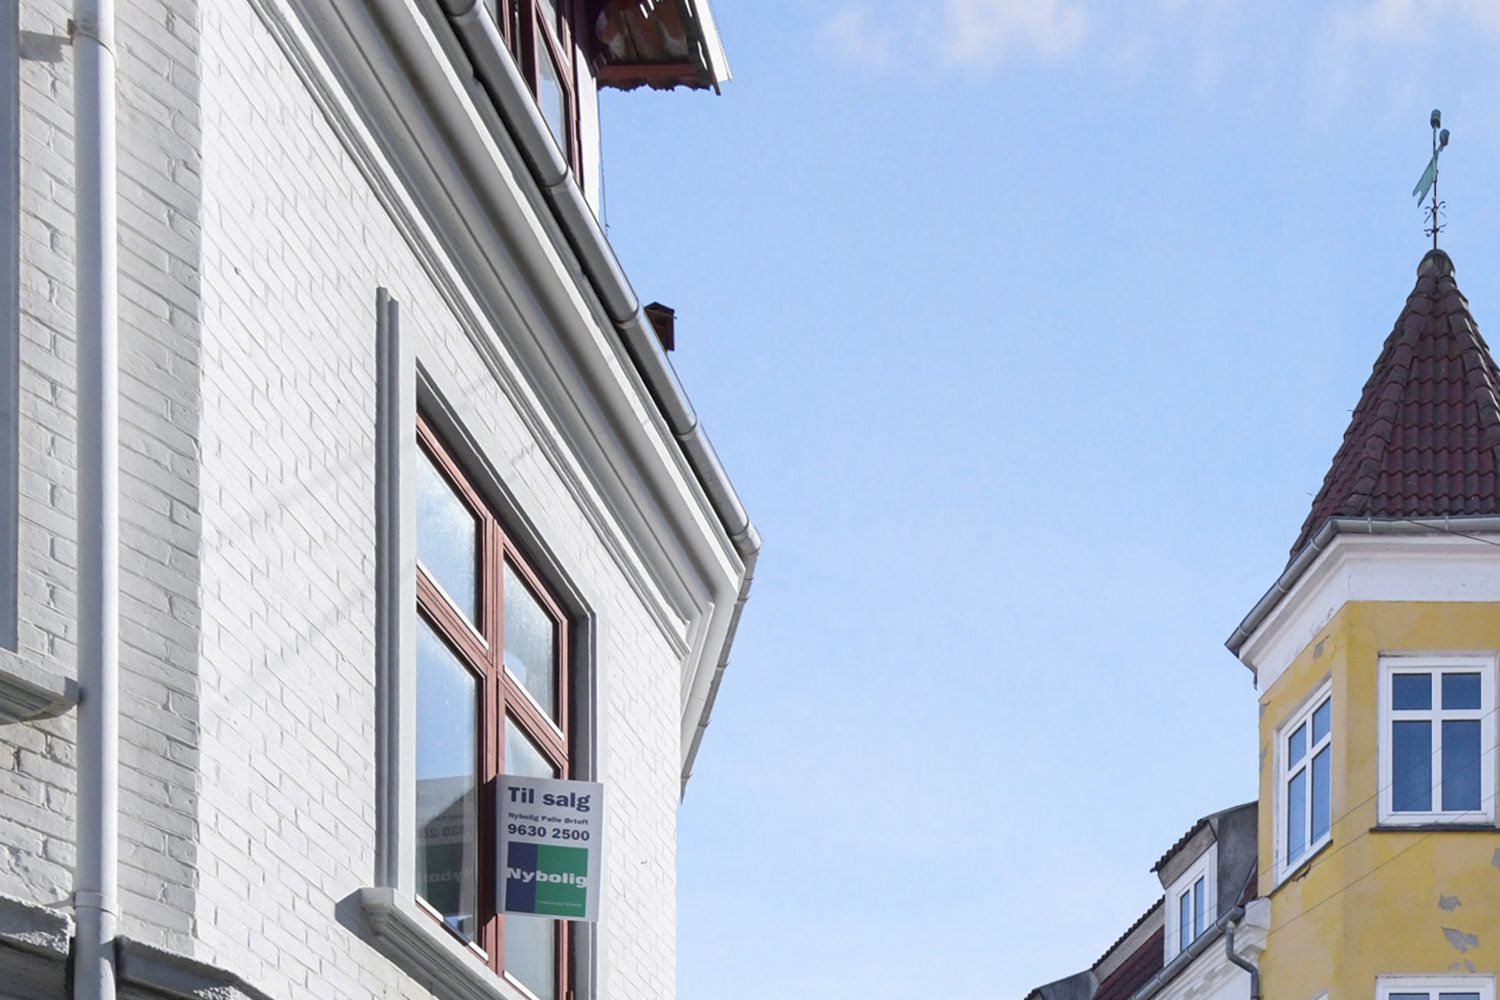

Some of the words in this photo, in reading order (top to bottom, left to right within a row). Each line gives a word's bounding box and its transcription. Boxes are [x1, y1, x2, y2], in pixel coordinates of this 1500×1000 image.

[508, 786, 534, 804] Til
[542, 792, 591, 812] salg
[508, 812, 539, 822] Nybolig
[541, 815, 562, 823] Palle
[507, 823, 547, 838] 9630
[551, 828, 590, 841] 2500
[507, 867, 588, 888] Nybolig
